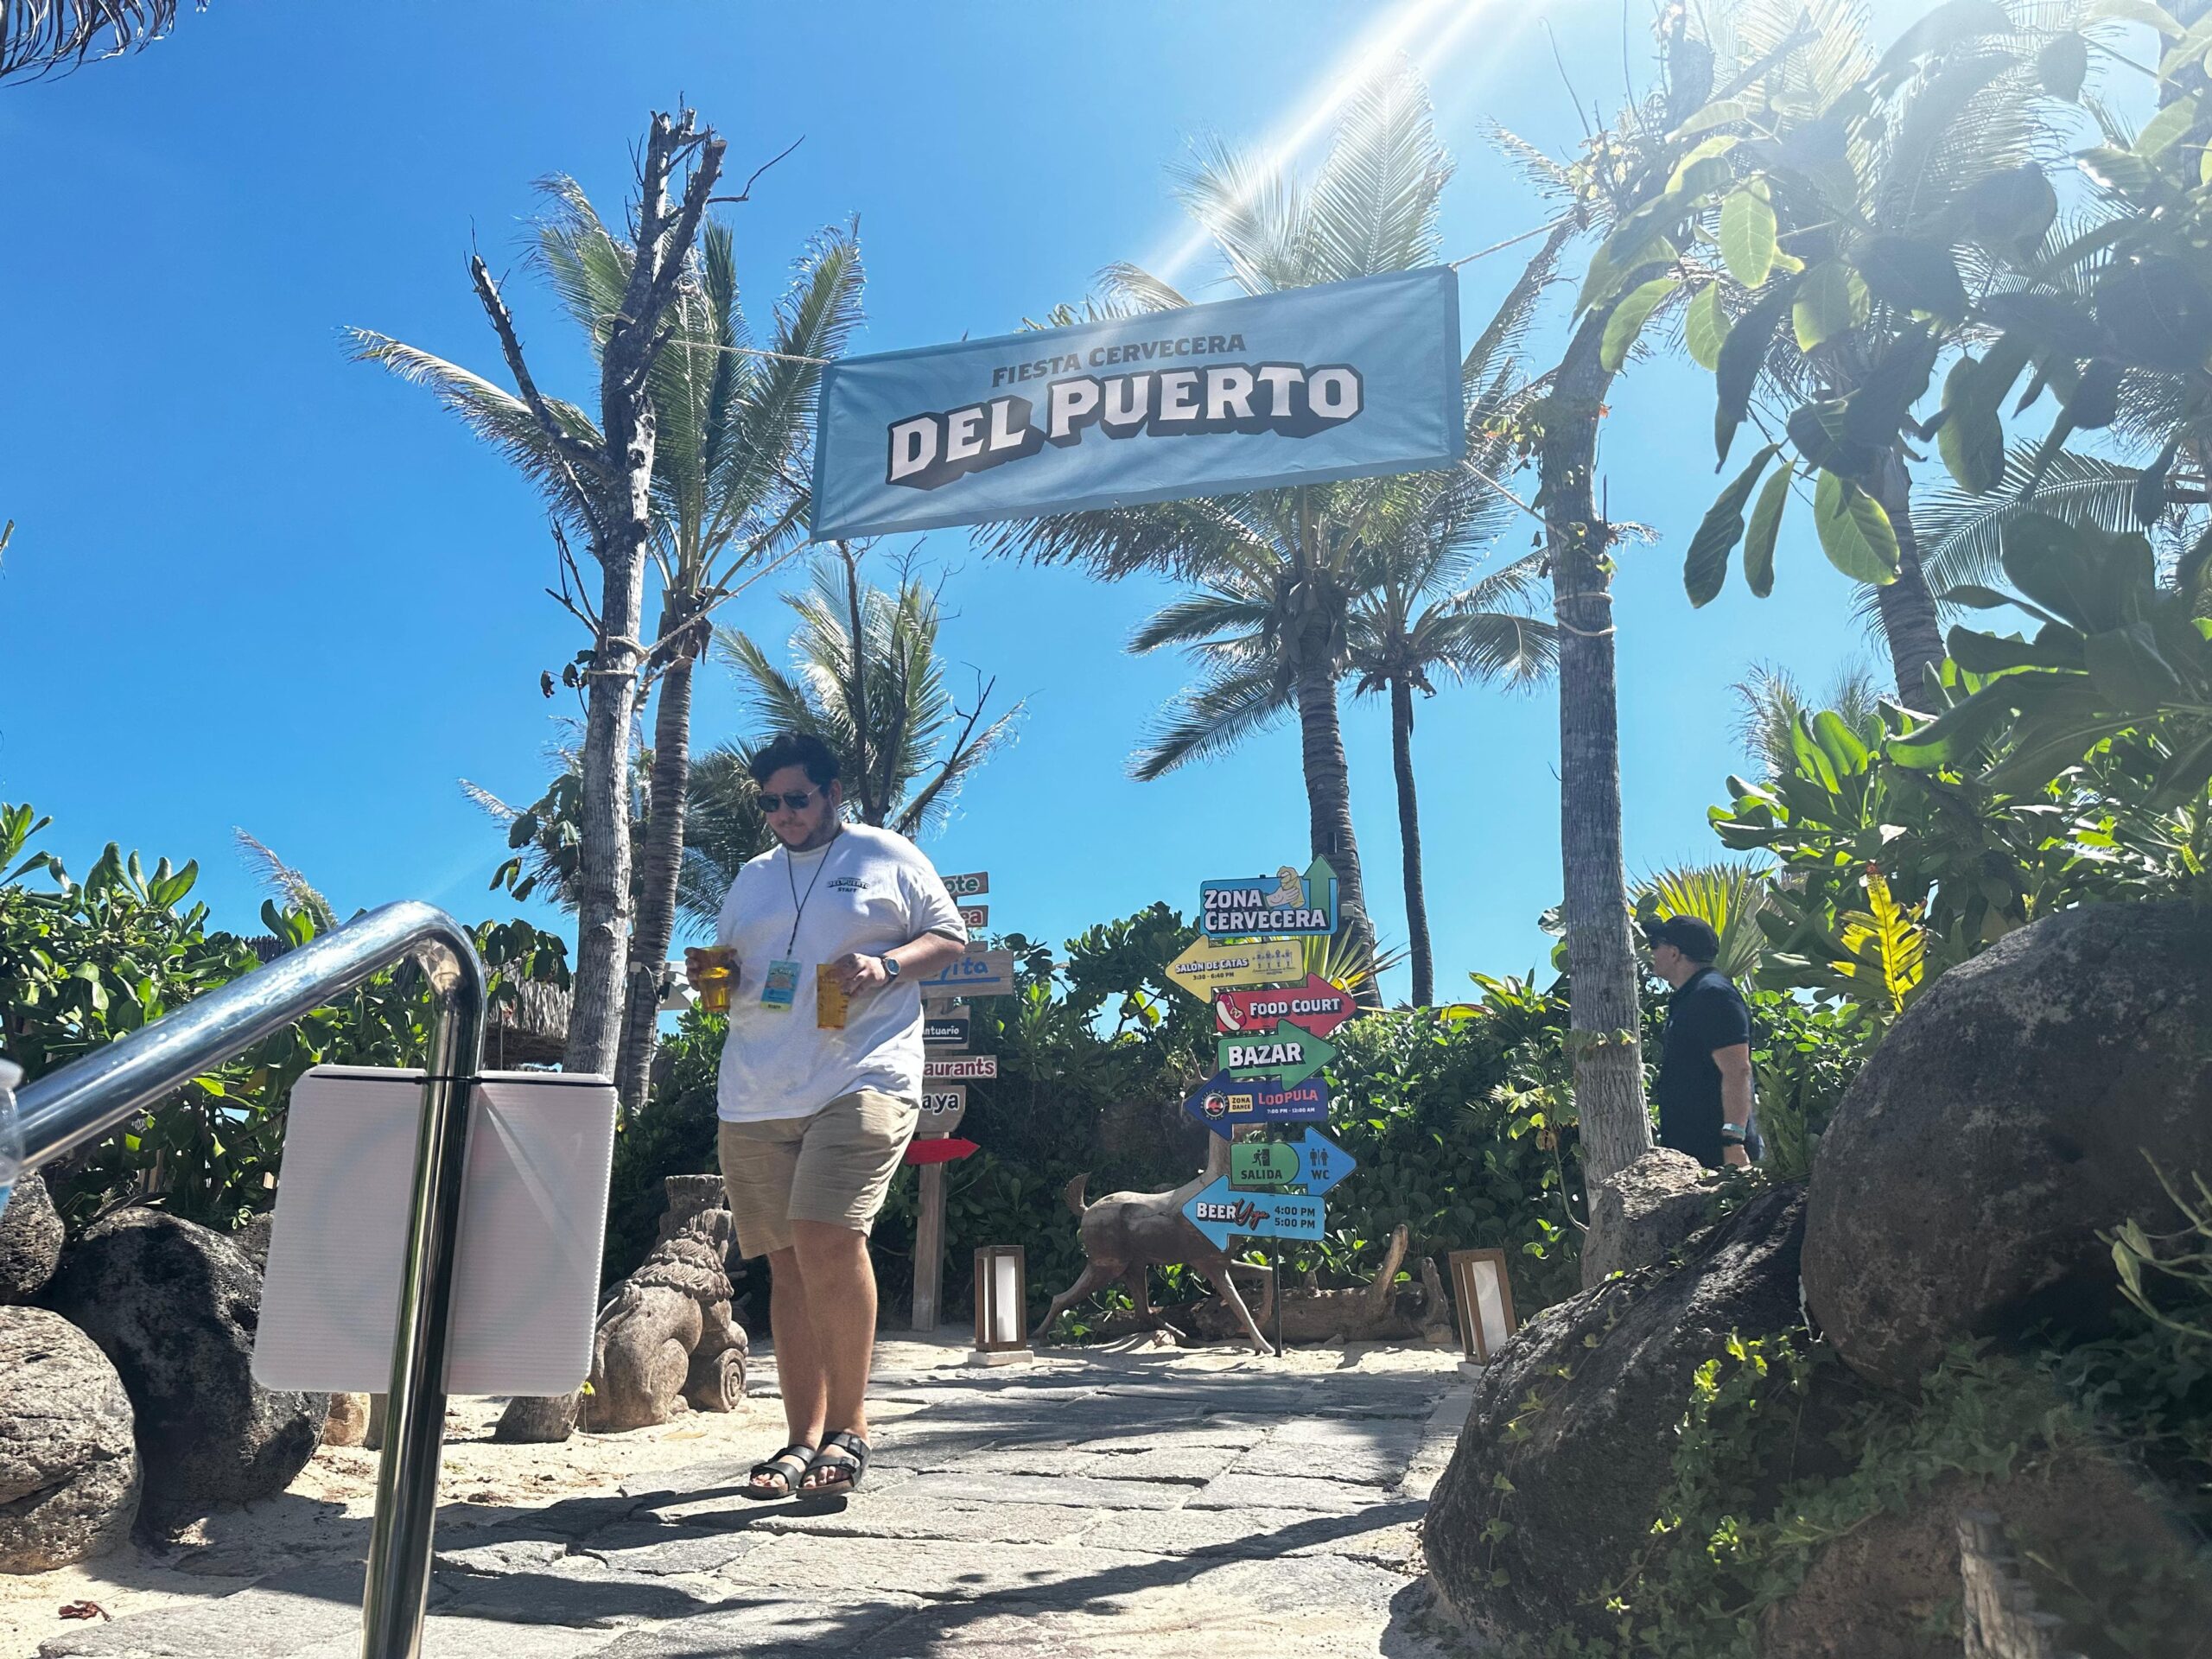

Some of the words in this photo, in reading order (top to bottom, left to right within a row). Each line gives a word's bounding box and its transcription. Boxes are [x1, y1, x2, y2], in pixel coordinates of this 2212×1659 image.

[992, 353, 1081, 388] FIESTA
[1089, 334, 1247, 367] CERVECERA
[888, 396, 1033, 486] DEL
[1050, 364, 1363, 441] PUERTO
[1203, 888, 1264, 910] ZONA
[1204, 909, 1328, 931] CERVECERA
[1175, 960, 1205, 974] SALÓN
[1206, 961, 1218, 971] DE
[1219, 957, 1249, 969] CATAS
[1249, 1001, 1289, 1017] FOOD
[1291, 997, 1341, 1014] COURT
[1227, 1042, 1304, 1067] BAZAR
[1258, 1090, 1319, 1105] LOOPULA
[1241, 1169, 1283, 1180] SALIDA
[1312, 1169, 1330, 1180] WC
[1197, 1202, 1236, 1221] BEER
[1274, 1205, 1298, 1216] 4:00
[1300, 1207, 1316, 1217] PM
[1274, 1217, 1298, 1227] 5:00
[1300, 1219, 1316, 1229] PM
